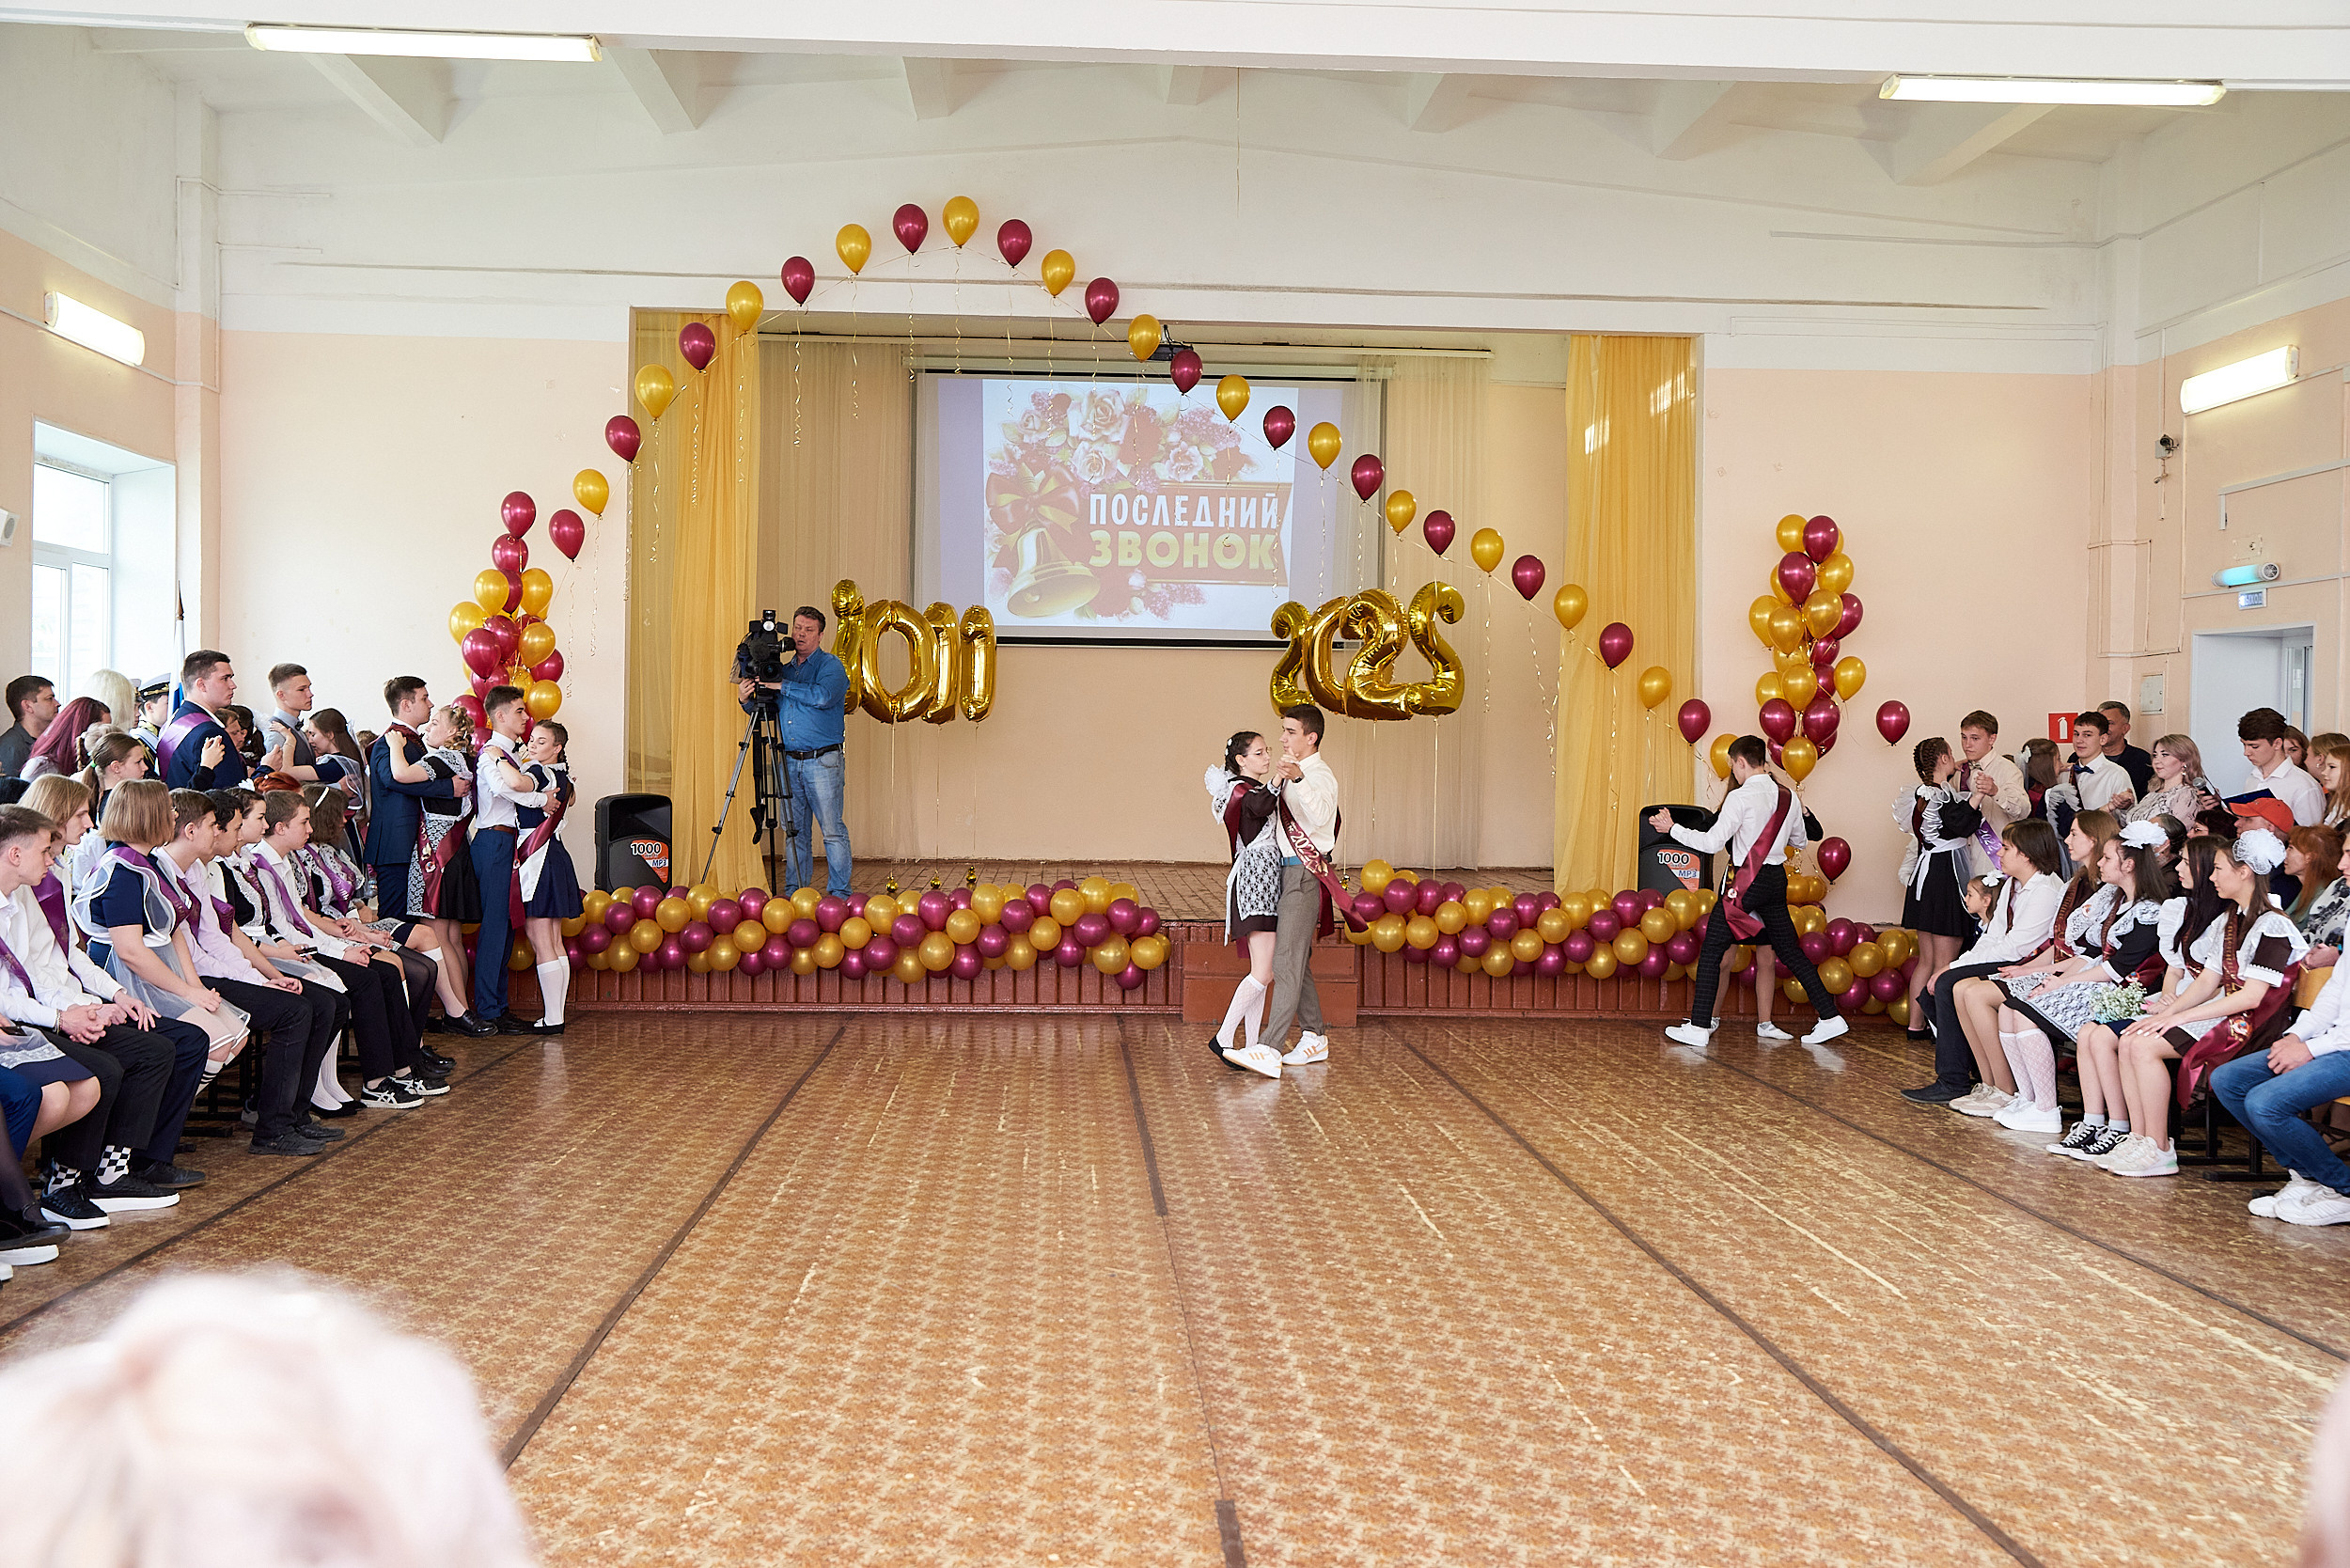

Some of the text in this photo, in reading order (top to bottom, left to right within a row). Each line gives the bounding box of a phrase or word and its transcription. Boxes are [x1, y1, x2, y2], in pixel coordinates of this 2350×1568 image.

[1089, 493, 1278, 529] ПОСЛЕДНИЙ
[1089, 529, 1277, 571] ЗВОНОК
[2240, 592, 2264, 606] ЫХОД
[630, 841, 662, 855] 1000
[651, 858, 667, 868] MP3
[1656, 851, 1691, 865] 1000
[1678, 870, 1697, 878] MP3
